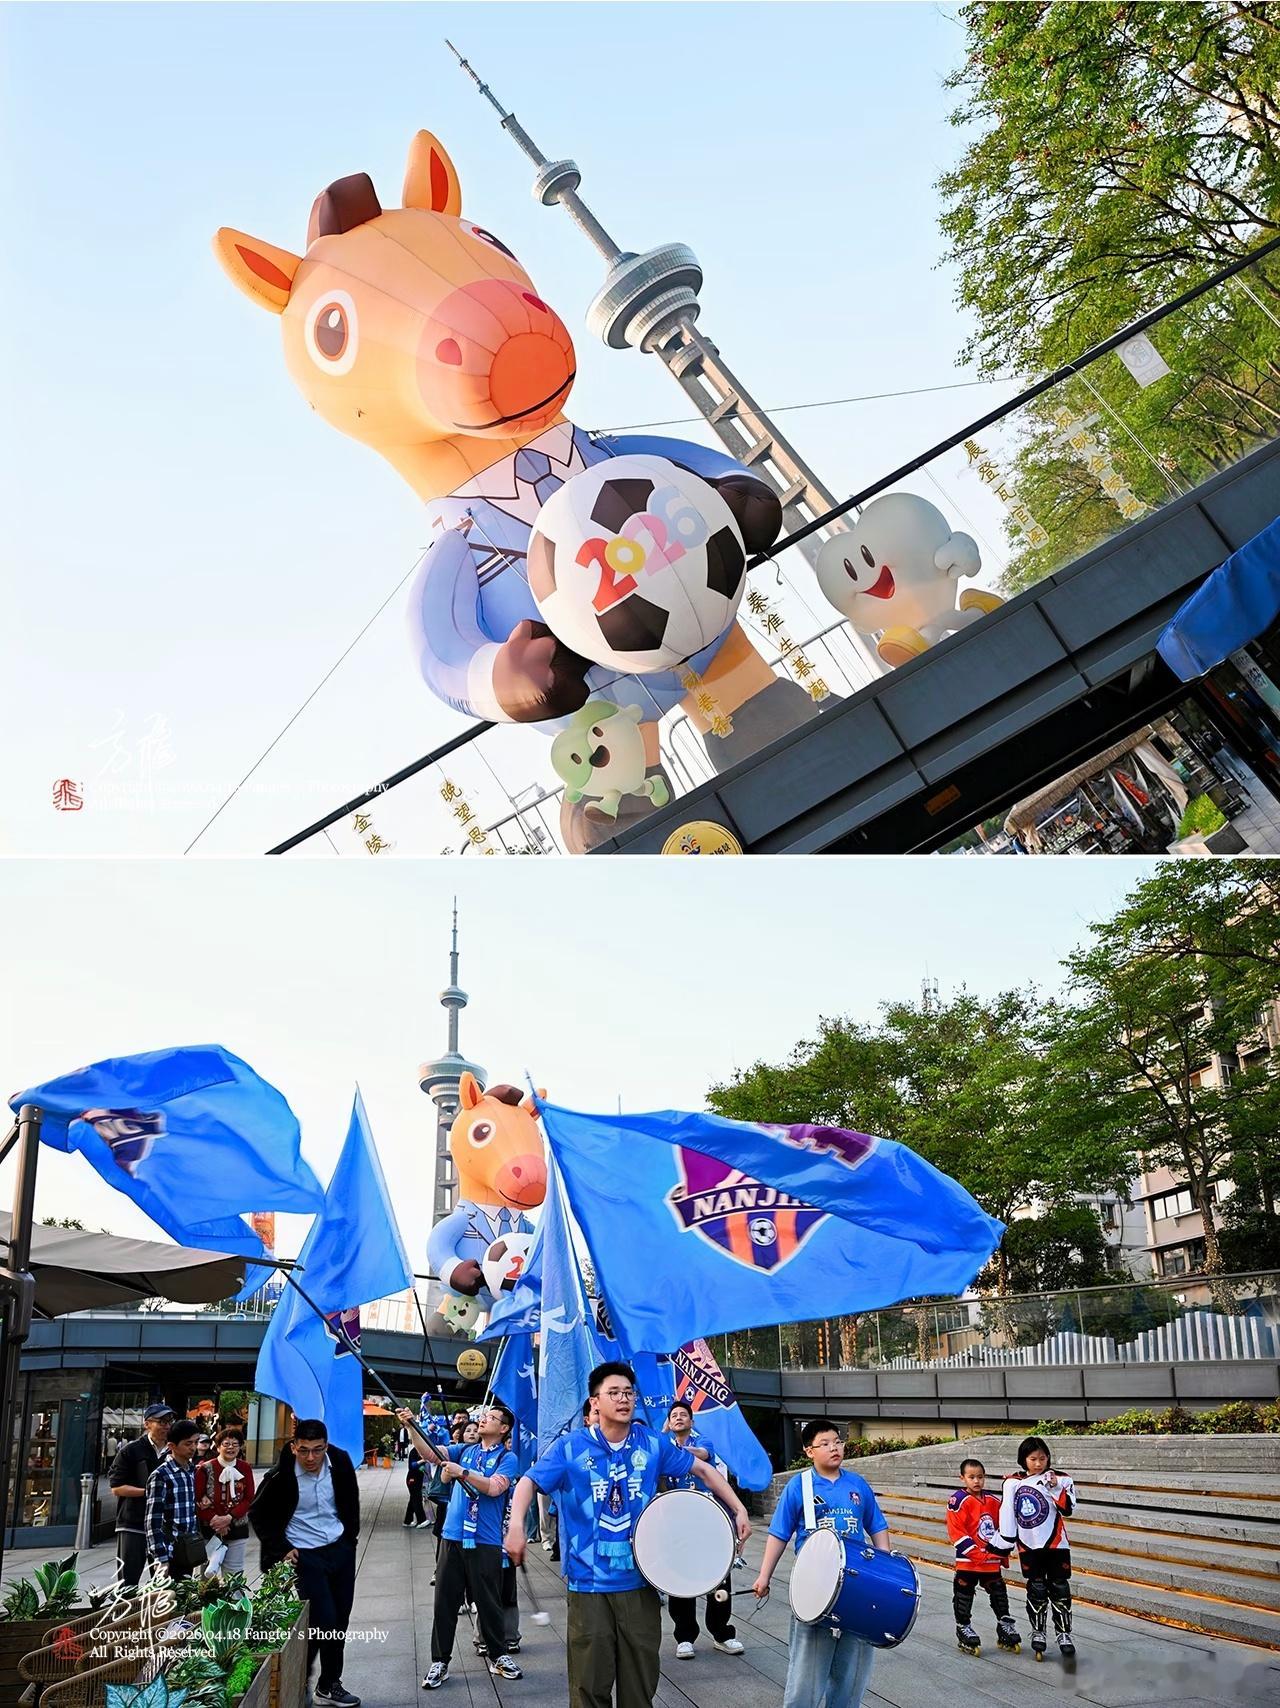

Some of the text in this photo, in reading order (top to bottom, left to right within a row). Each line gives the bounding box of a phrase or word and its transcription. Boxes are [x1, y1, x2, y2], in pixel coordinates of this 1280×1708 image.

[962, 438, 1049, 546] 晨登瓦官阁
[575, 486, 708, 613] 2026
[746, 590, 831, 702] 秦淮生暮潮
[352, 812, 389, 854] 金陵
[675, 1351, 729, 1402] NANJING
[590, 1478, 643, 1503] 南京
